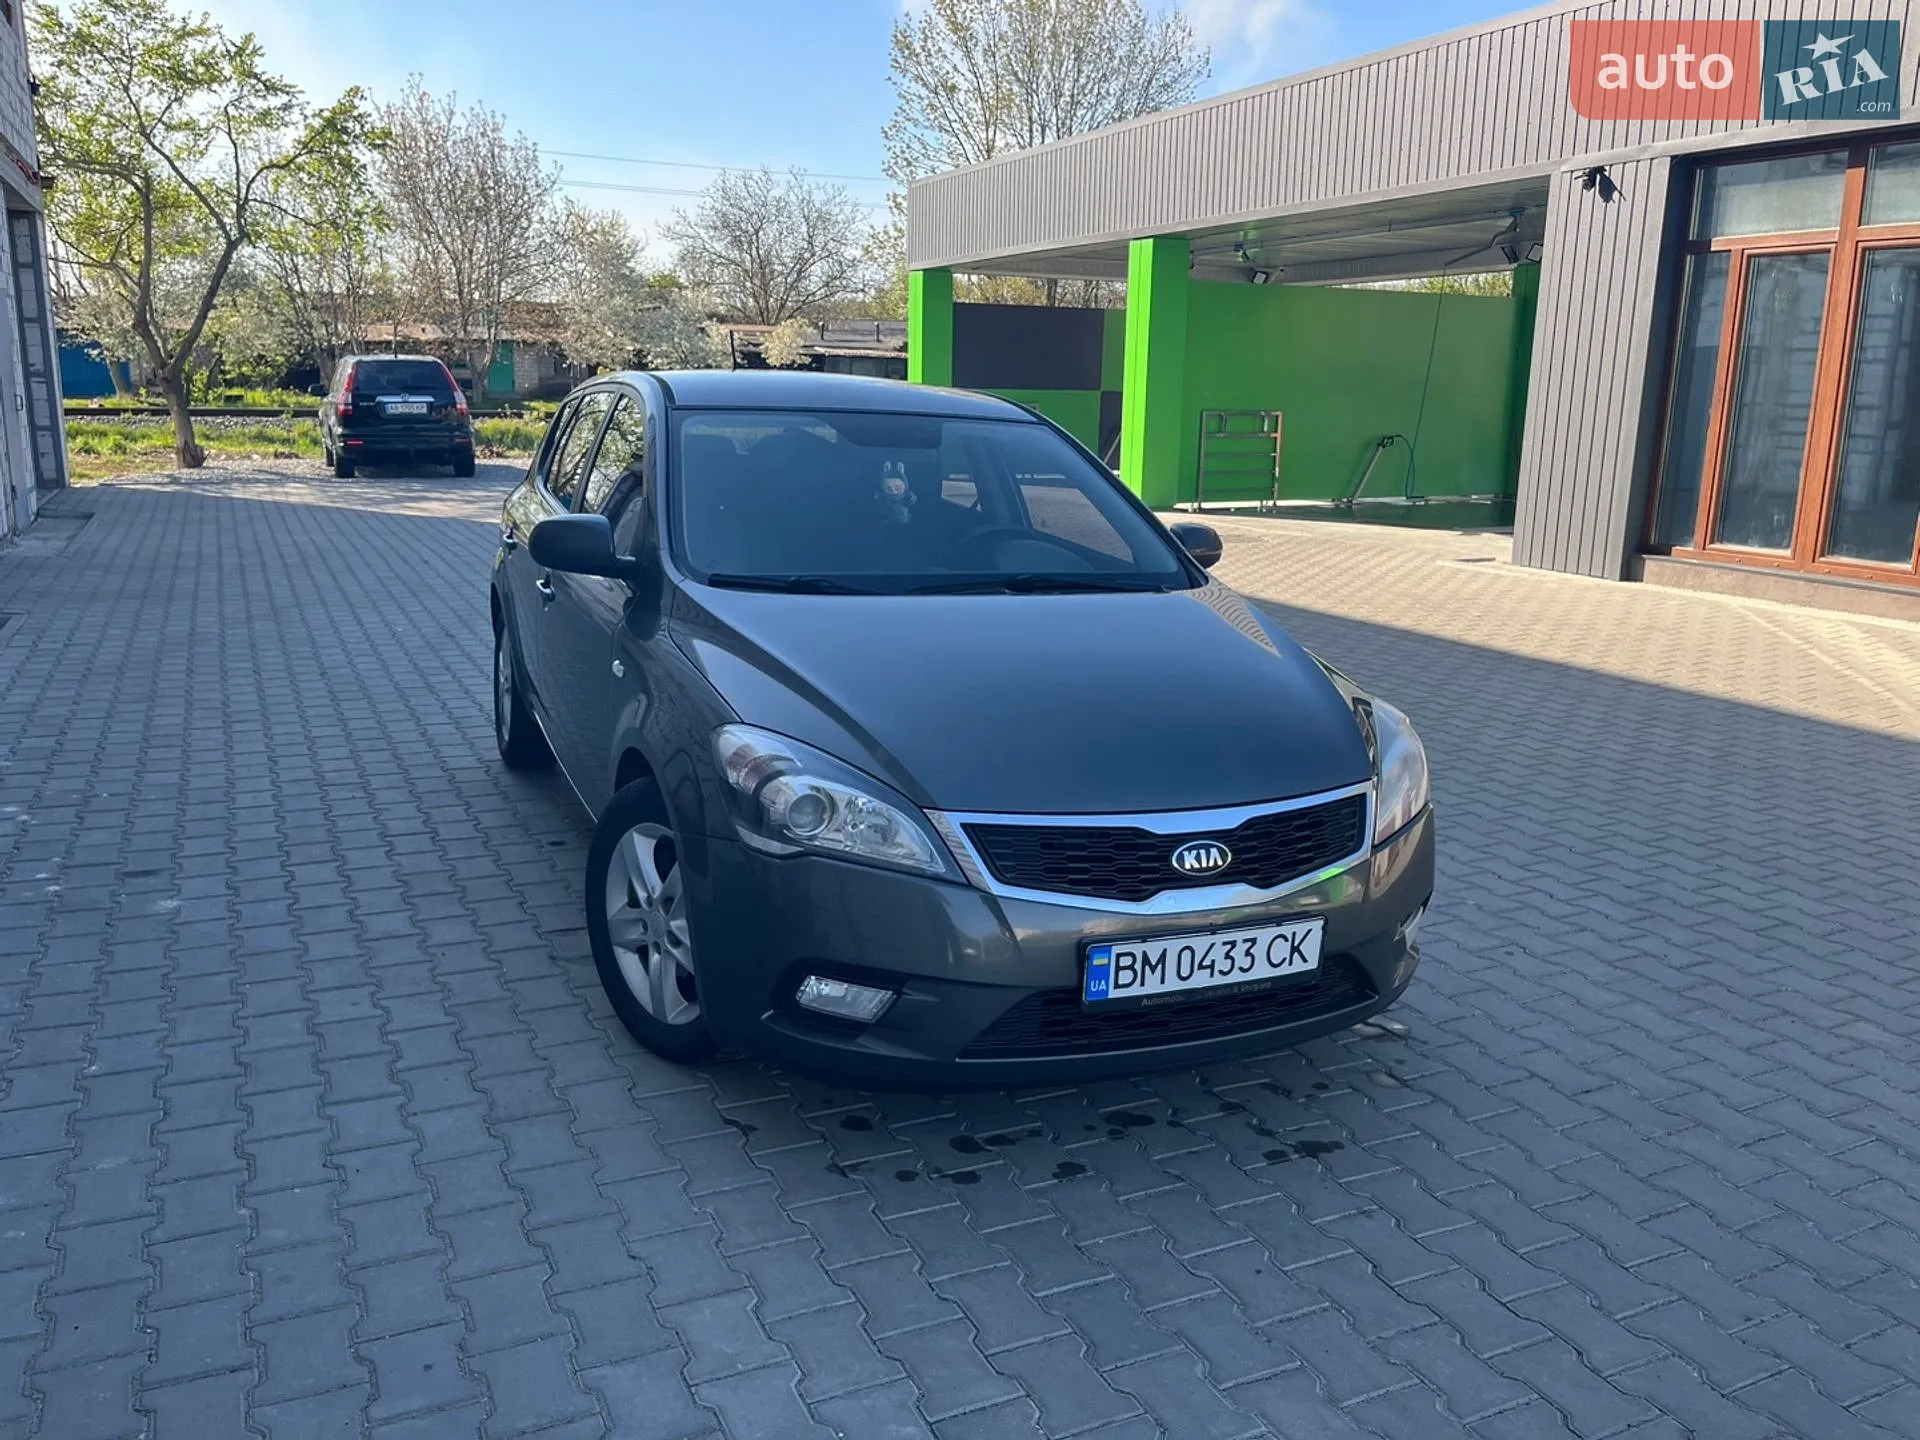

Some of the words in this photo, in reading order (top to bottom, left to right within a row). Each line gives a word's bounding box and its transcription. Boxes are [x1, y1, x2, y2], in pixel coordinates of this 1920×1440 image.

[1182, 847, 1223, 870] KIA
[1113, 947, 1168, 990] BM
[1176, 937, 1258, 983] 0433
[1266, 928, 1313, 969] CK
[1090, 980, 1107, 992] UA
